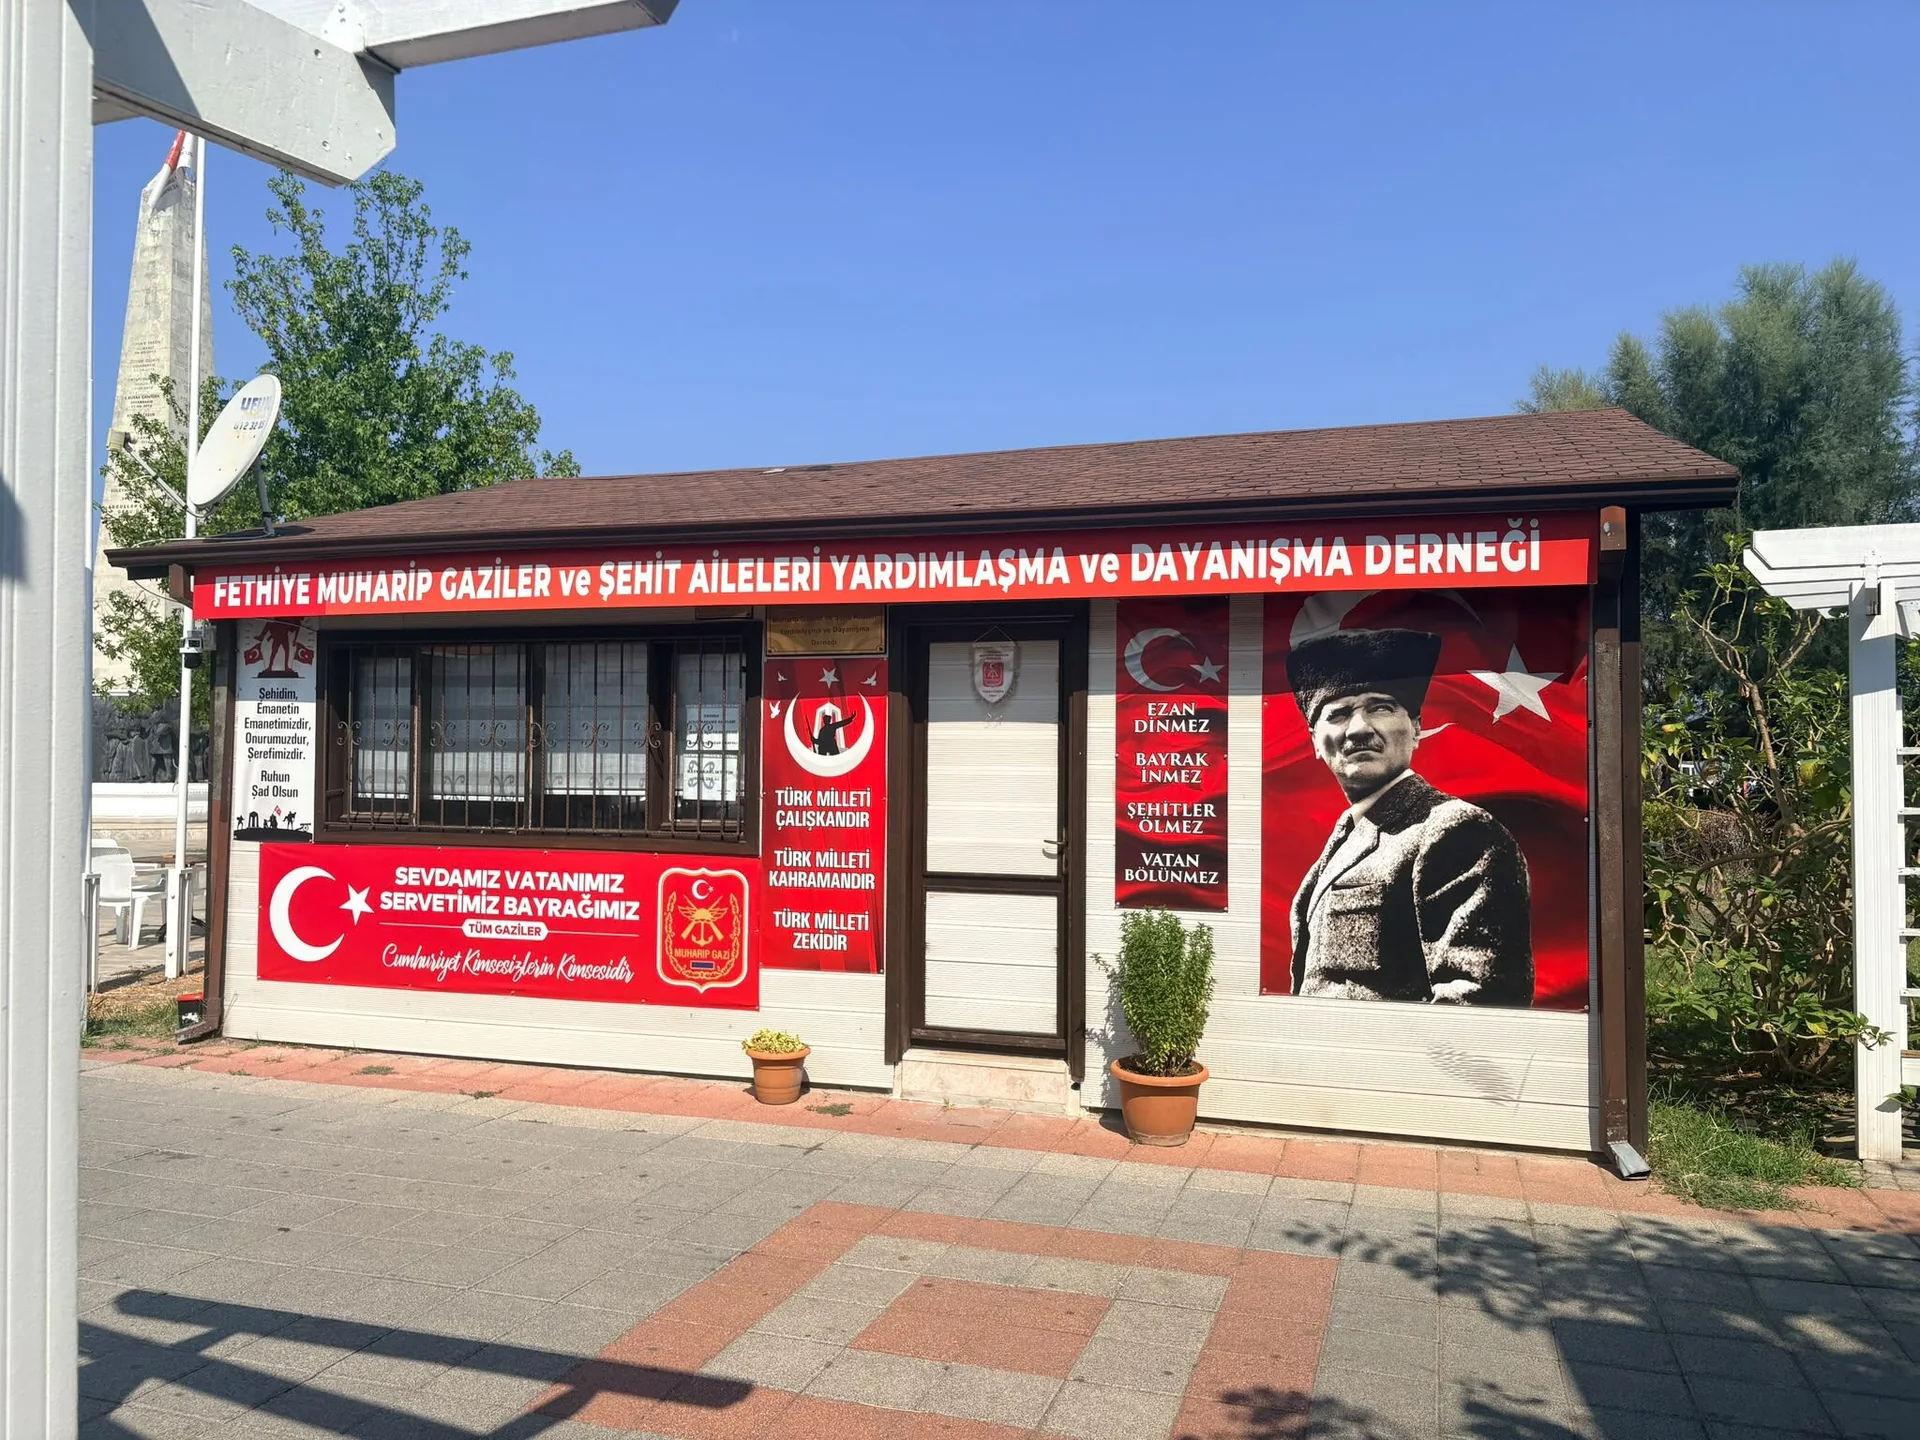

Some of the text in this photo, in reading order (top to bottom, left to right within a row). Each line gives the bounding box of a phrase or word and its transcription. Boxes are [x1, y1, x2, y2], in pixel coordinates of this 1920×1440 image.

[214, 518, 1541, 607] FETHİYE MUHARİP GAZİLER ve ŞEHİT AİLELERİ YARDIMLAŞMA ve DAYANIŞMA DERNEĞİ
[259, 687, 298, 702] Şehidim,
[257, 703, 299, 715] Emanetin
[1147, 703, 1195, 716] EZAN
[244, 717, 312, 731] Emanetimizdir,
[1134, 718, 1209, 733] DİNMEZ
[245, 732, 310, 746] Onurumuzdur,
[247, 747, 306, 762] Şerefimizdir.
[1136, 753, 1208, 766] BAYRAK
[260, 770, 290, 782] Ruhun
[1141, 767, 1201, 783] İNMEZ
[251, 785, 299, 799] Şad Olsun
[775, 786, 870, 807] TÜRK MİLLETİ
[1127, 801, 1216, 819] ŞEHİTLER
[776, 810, 869, 831] ÇALIŞKANDIR
[1139, 817, 1203, 833] ÖLMEZ
[774, 847, 870, 868] TÜRK MİLLETİ
[1141, 852, 1199, 867] VATAN
[395, 867, 624, 893] SEVDAMIZ VATANIMIZ
[769, 870, 875, 890] KAHRAMANDIR
[1125, 867, 1218, 884] BÖLÜNMEZ
[380, 889, 640, 920] SERVETİMİZ BAYRAĞIMIZ
[773, 908, 869, 930] TÜRK MİLLETİ
[468, 921, 541, 936] TÜM GAZİLER
[793, 930, 847, 950] ZEKİDİR
[382, 943, 635, 984] Cumhuriyet Kimsesizlerin Kimsesidir
